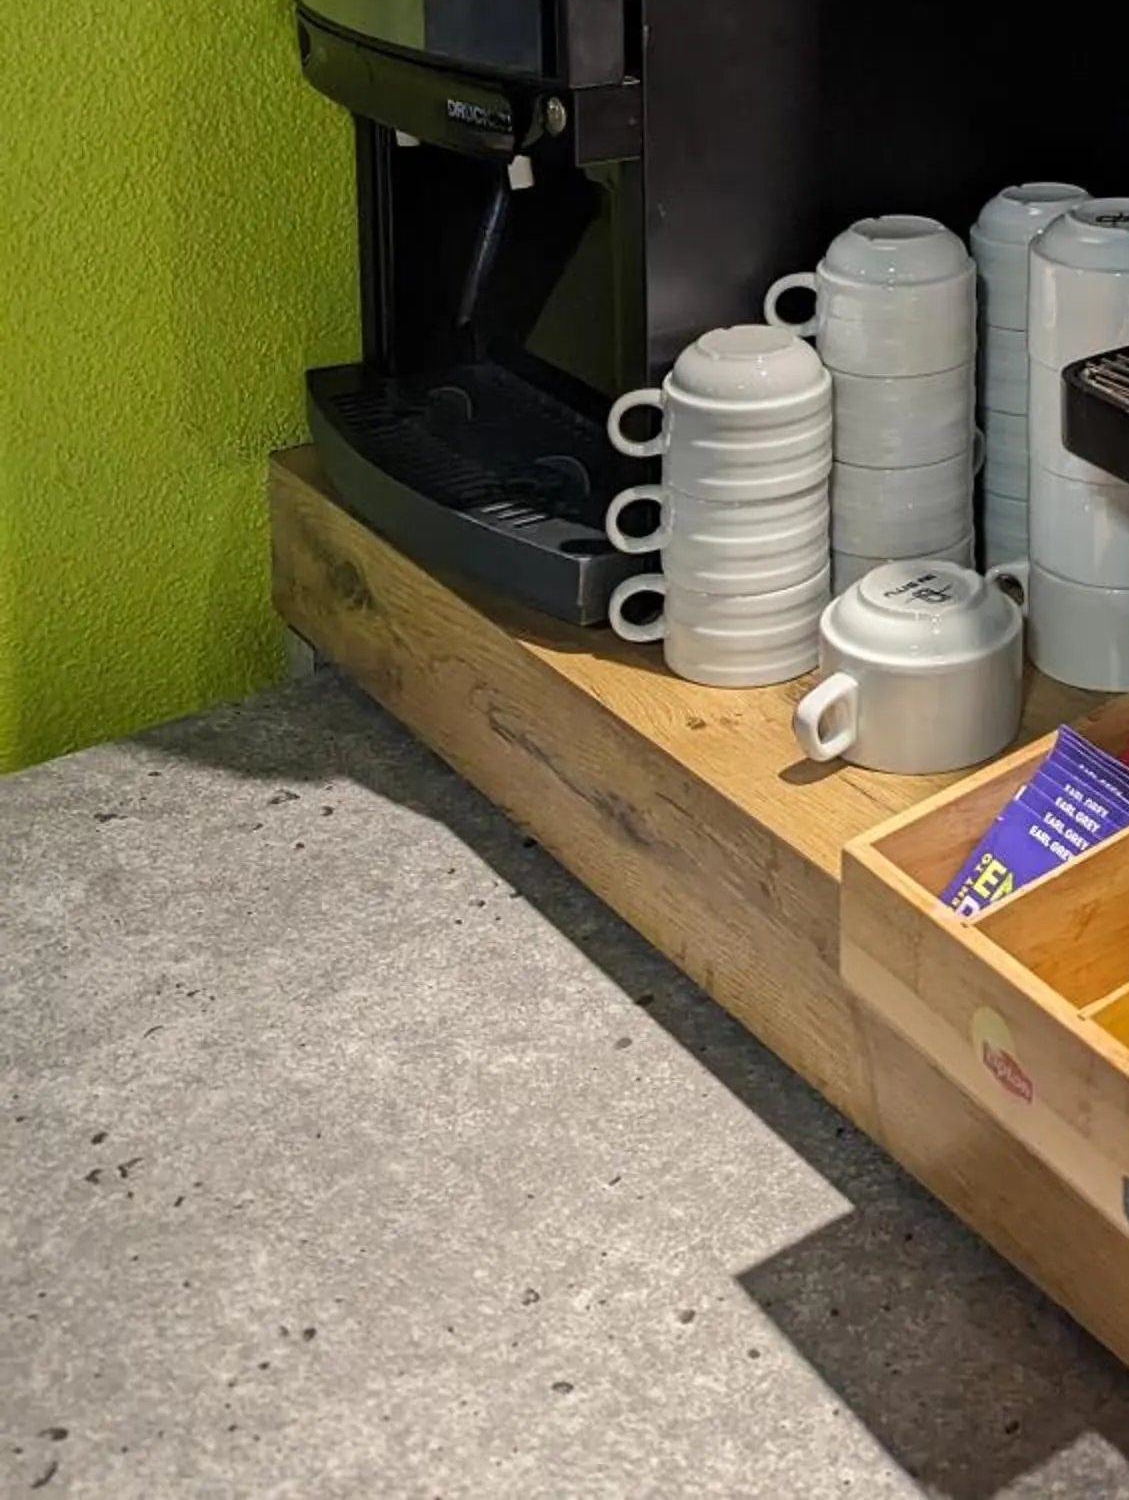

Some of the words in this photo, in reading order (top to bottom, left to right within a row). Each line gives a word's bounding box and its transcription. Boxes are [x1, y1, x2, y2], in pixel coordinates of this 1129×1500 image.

[1055, 796, 1076, 816] EARL
[1075, 811, 1101, 833] GREY
[1064, 783, 1084, 803] EARL
[1083, 795, 1110, 819] GREY
[1029, 825, 1052, 847] EARL
[1043, 811, 1065, 834] EARL
[1064, 828, 1090, 851] GREY
